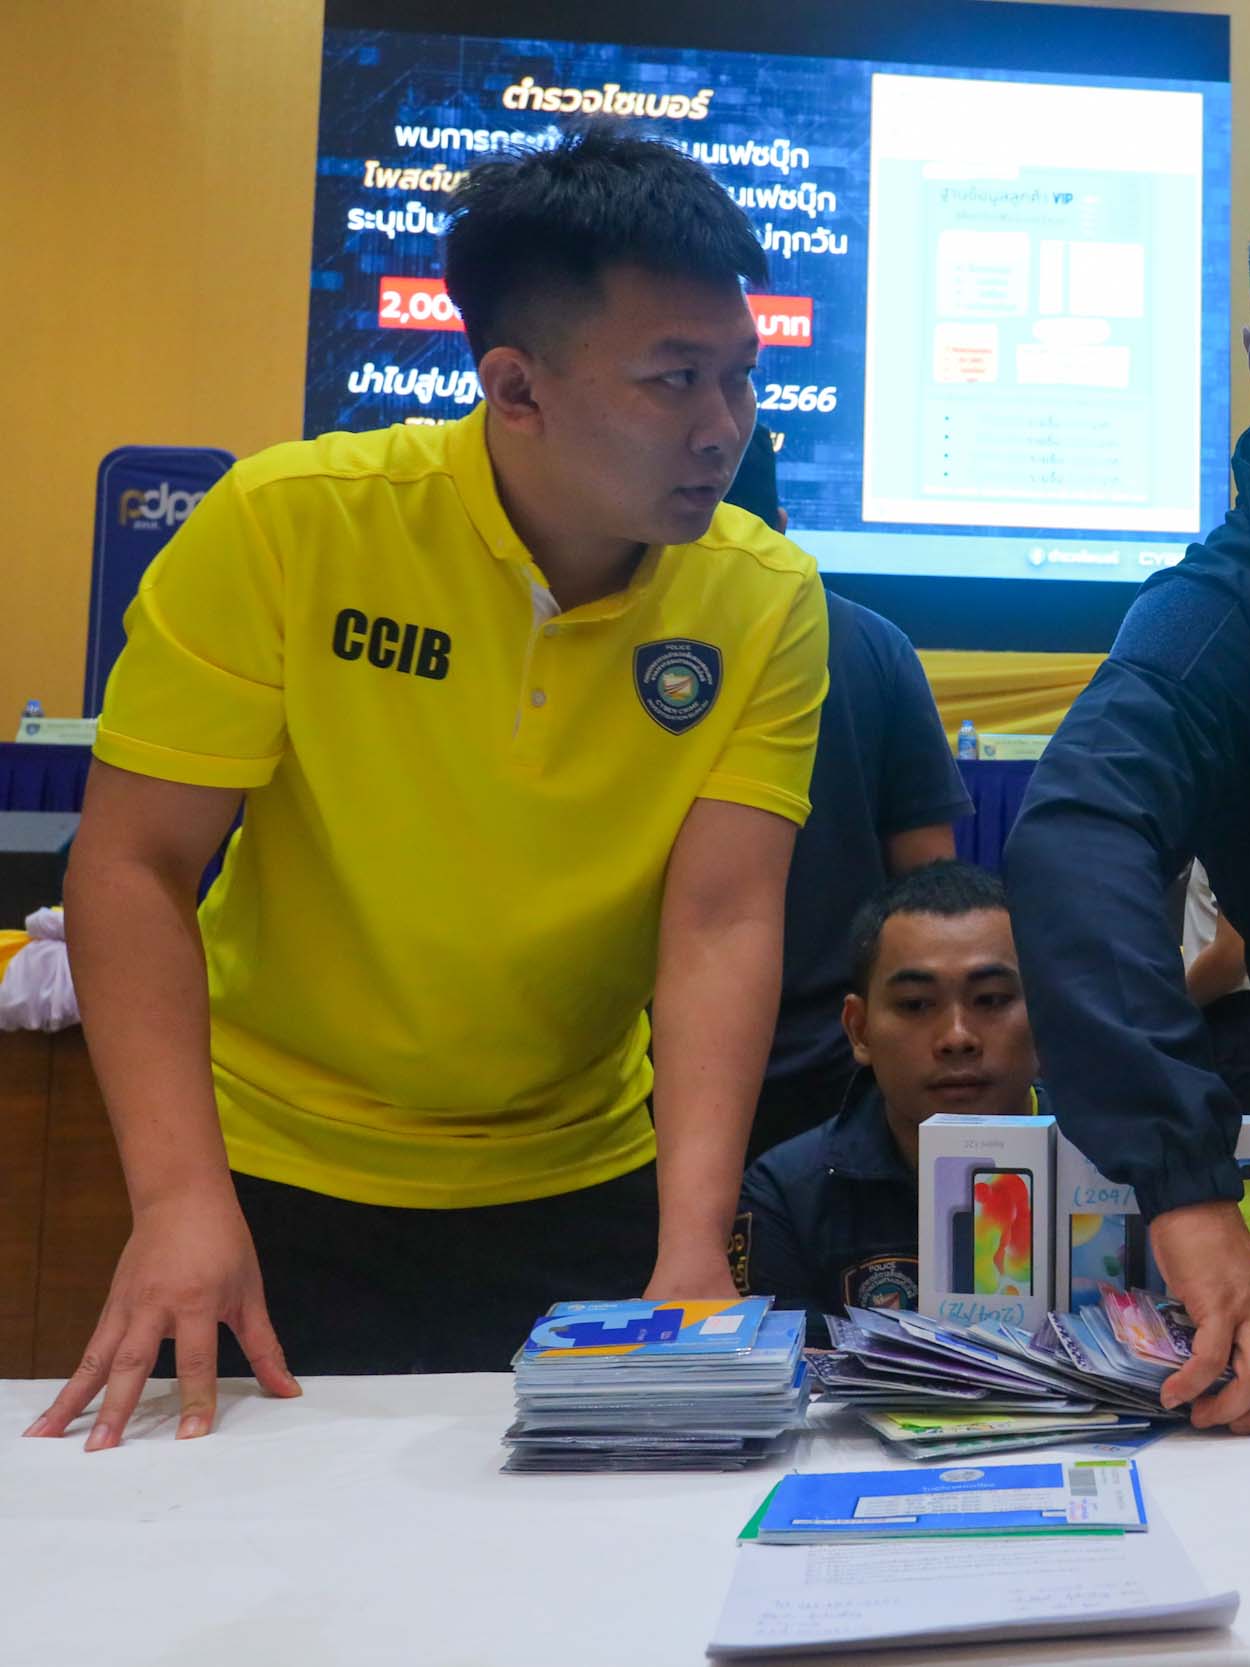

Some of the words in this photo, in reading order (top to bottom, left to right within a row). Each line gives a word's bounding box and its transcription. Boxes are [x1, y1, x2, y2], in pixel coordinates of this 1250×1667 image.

[502, 77, 712, 120] ตำรวจไซเบอร์
[380, 291, 463, 324] 2,00
[757, 313, 811, 337] บาท
[332, 607, 452, 681] CCIB
